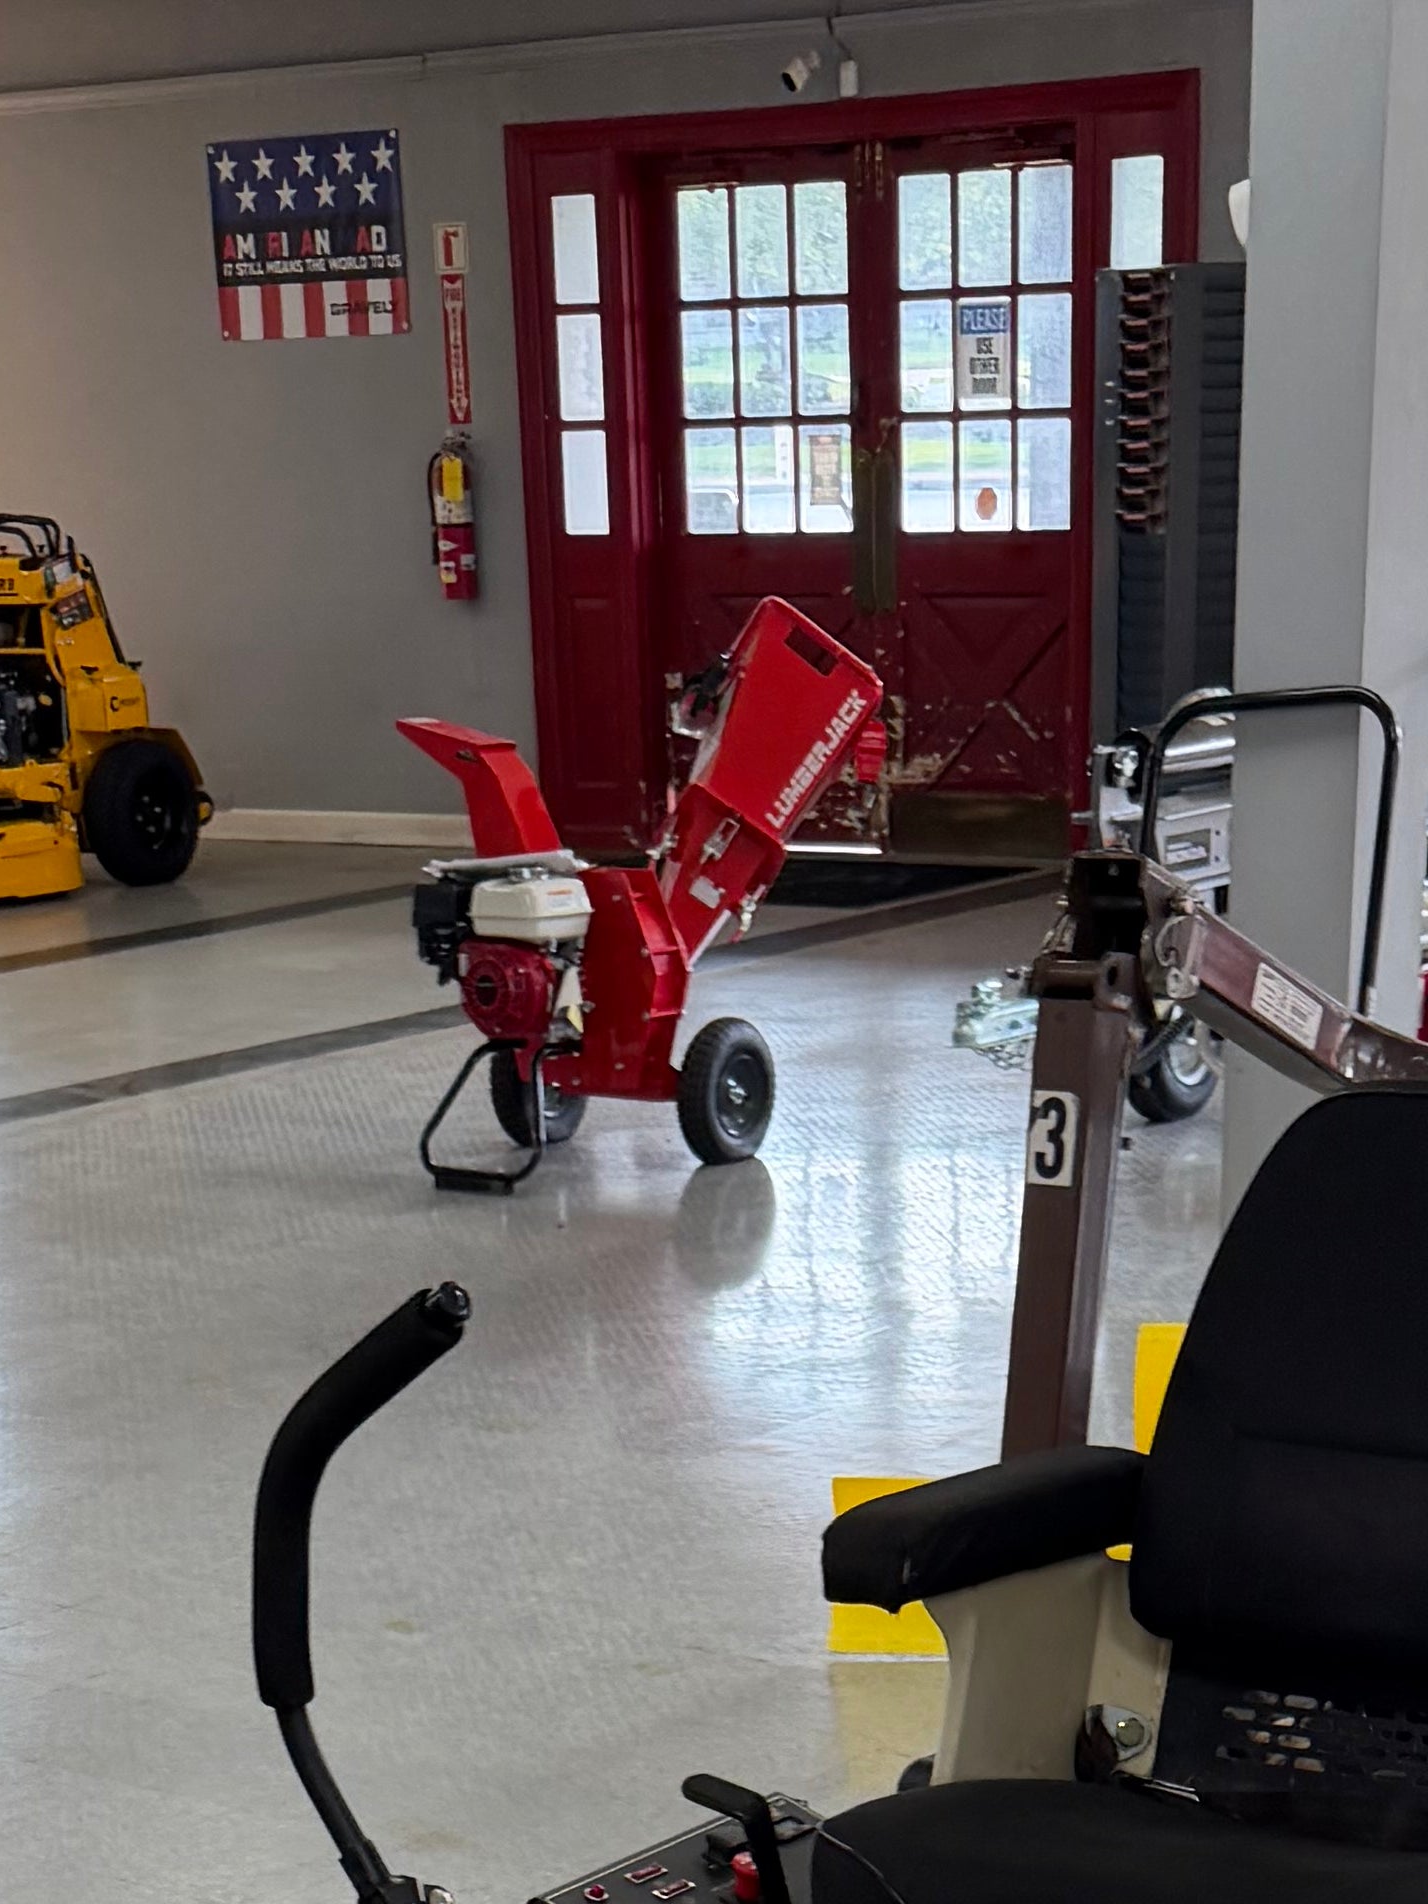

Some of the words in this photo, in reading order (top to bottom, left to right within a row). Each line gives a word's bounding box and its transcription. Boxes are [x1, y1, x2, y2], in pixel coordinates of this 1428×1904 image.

[235, 261, 264, 276] STILL
[305, 258, 326, 272] THE
[328, 256, 367, 271] WORLD
[369, 255, 385, 269] TO
[387, 254, 402, 267] US
[962, 307, 1007, 330] PLEASE
[765, 688, 868, 828] LUMBERJACK
[1035, 1097, 1066, 1179] 3
